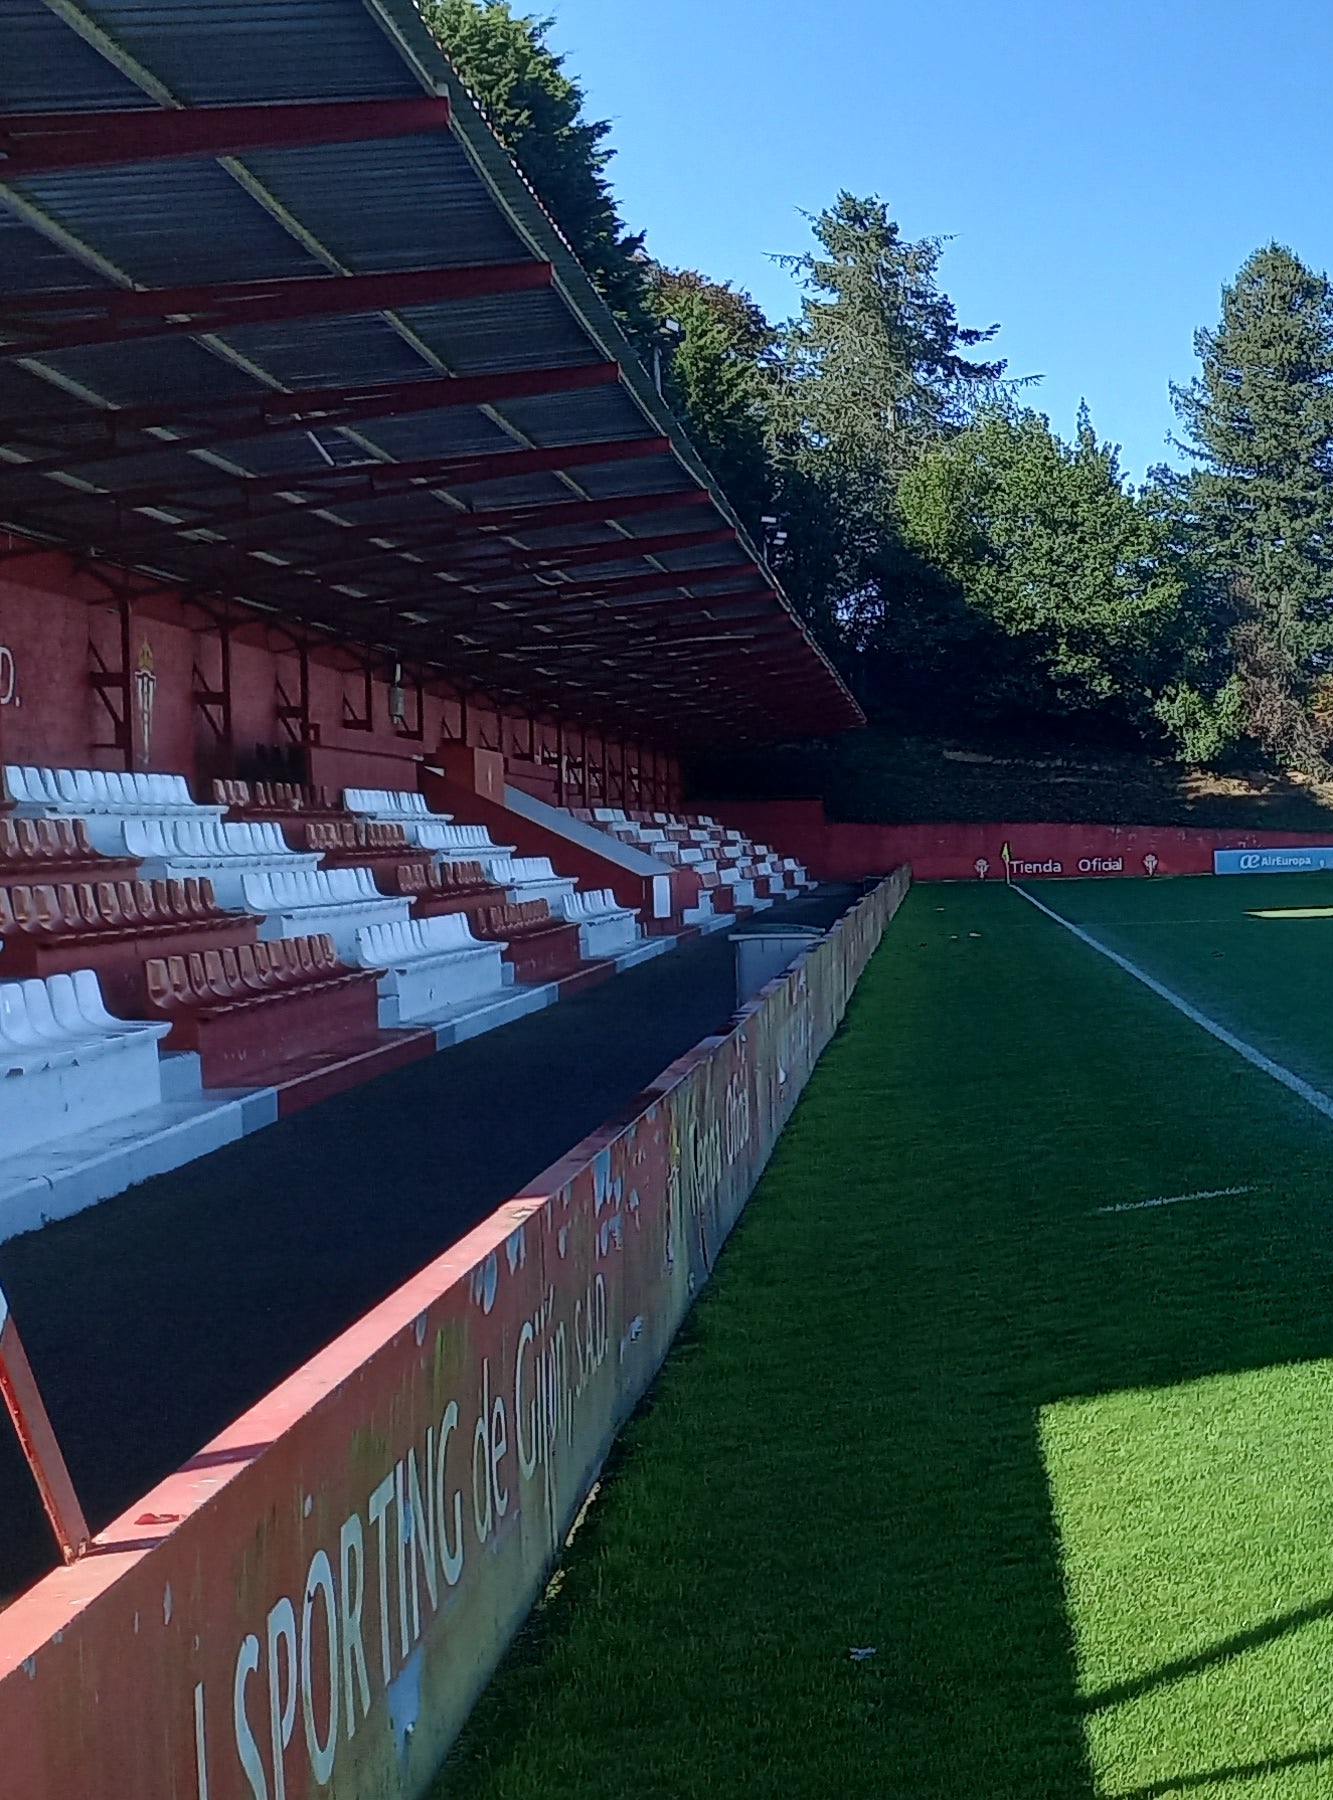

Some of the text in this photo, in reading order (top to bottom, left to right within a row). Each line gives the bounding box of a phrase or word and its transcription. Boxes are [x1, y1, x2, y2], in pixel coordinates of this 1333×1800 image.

[1010, 857, 1122, 873] Tienda Oficial
[234, 1400, 463, 1800] SPORTING
[473, 1357, 508, 1543] de
